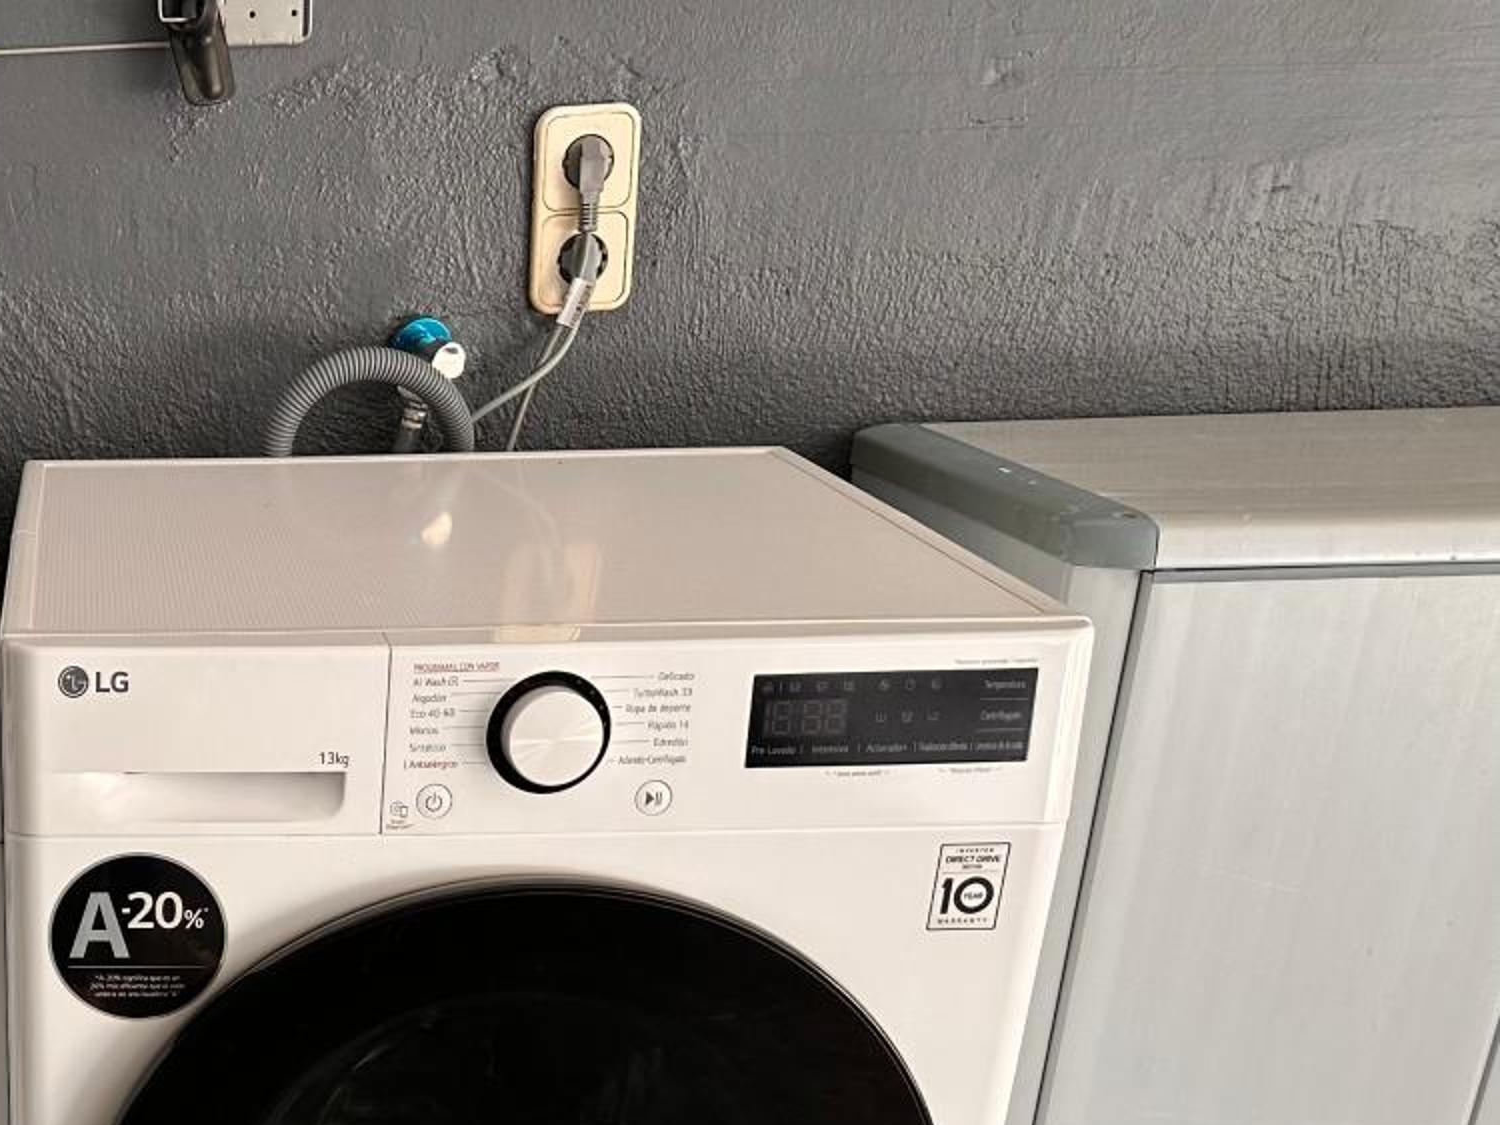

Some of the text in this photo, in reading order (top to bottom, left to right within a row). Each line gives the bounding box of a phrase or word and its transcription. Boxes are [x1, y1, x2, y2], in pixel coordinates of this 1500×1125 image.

[95, 671, 129, 693] LG
[319, 751, 350, 769] 13kg
[945, 854, 1001, 864] DIRECT DRIVE
[938, 875, 995, 914] 10
